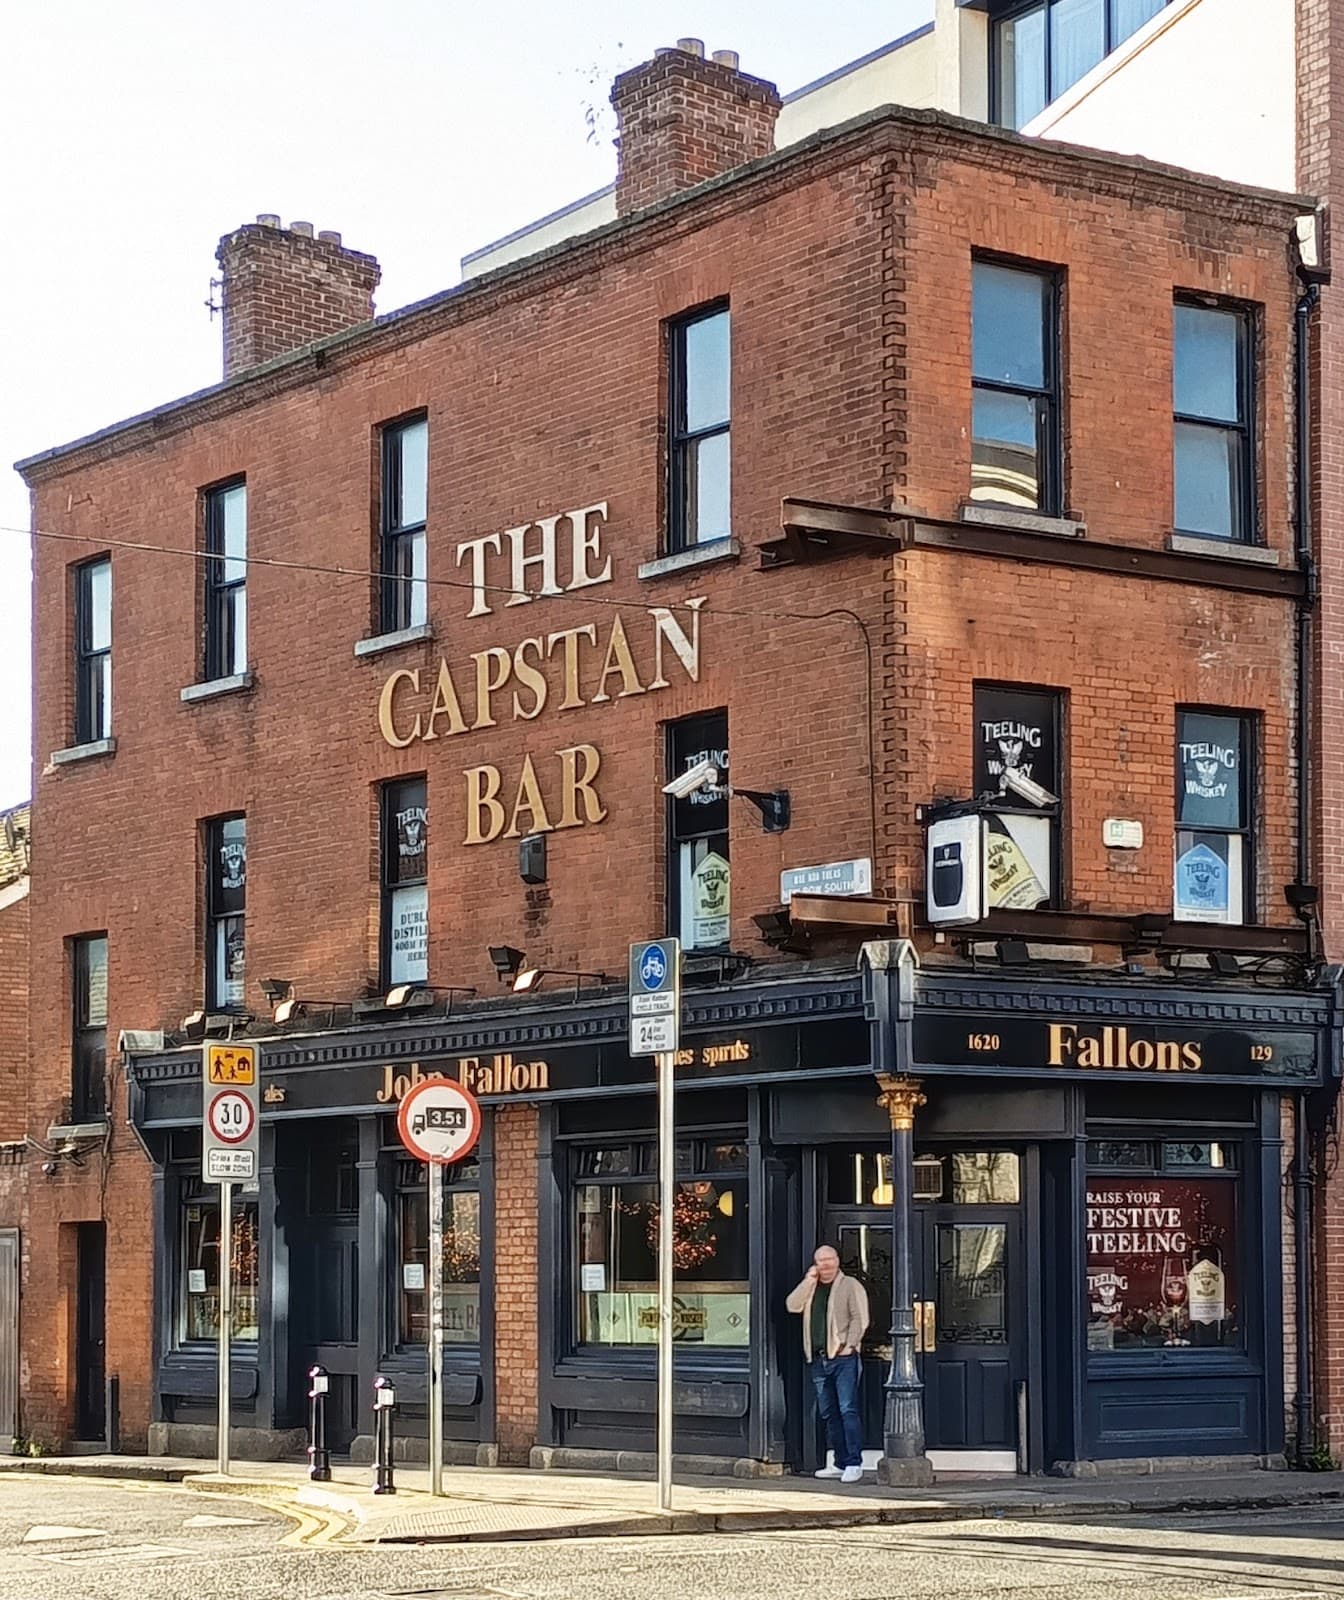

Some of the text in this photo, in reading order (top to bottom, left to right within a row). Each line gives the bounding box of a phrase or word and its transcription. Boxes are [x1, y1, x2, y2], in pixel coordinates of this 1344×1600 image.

[455, 501, 612, 618] THE
[378, 596, 707, 748] CAPSTAN
[981, 721, 1041, 747] TEELING
[1180, 743, 1235, 768] TEELING
[462, 744, 607, 845] BAR
[1184, 863, 1220, 879] TEELING
[640, 1026, 653, 1042] 24
[968, 1034, 1000, 1050] 1620
[1047, 1023, 1202, 1071] Fallons
[1250, 1045, 1273, 1061] 129
[458, 1053, 549, 1094] Fallon
[221, 1103, 242, 1124] 30
[431, 1110, 463, 1126] 3.5t
[1086, 1192, 1161, 1203] RAISE YOUR
[1086, 1207, 1181, 1228] FESTIVE
[1087, 1232, 1187, 1253] TEELING
[1087, 1273, 1129, 1290] TEELING
